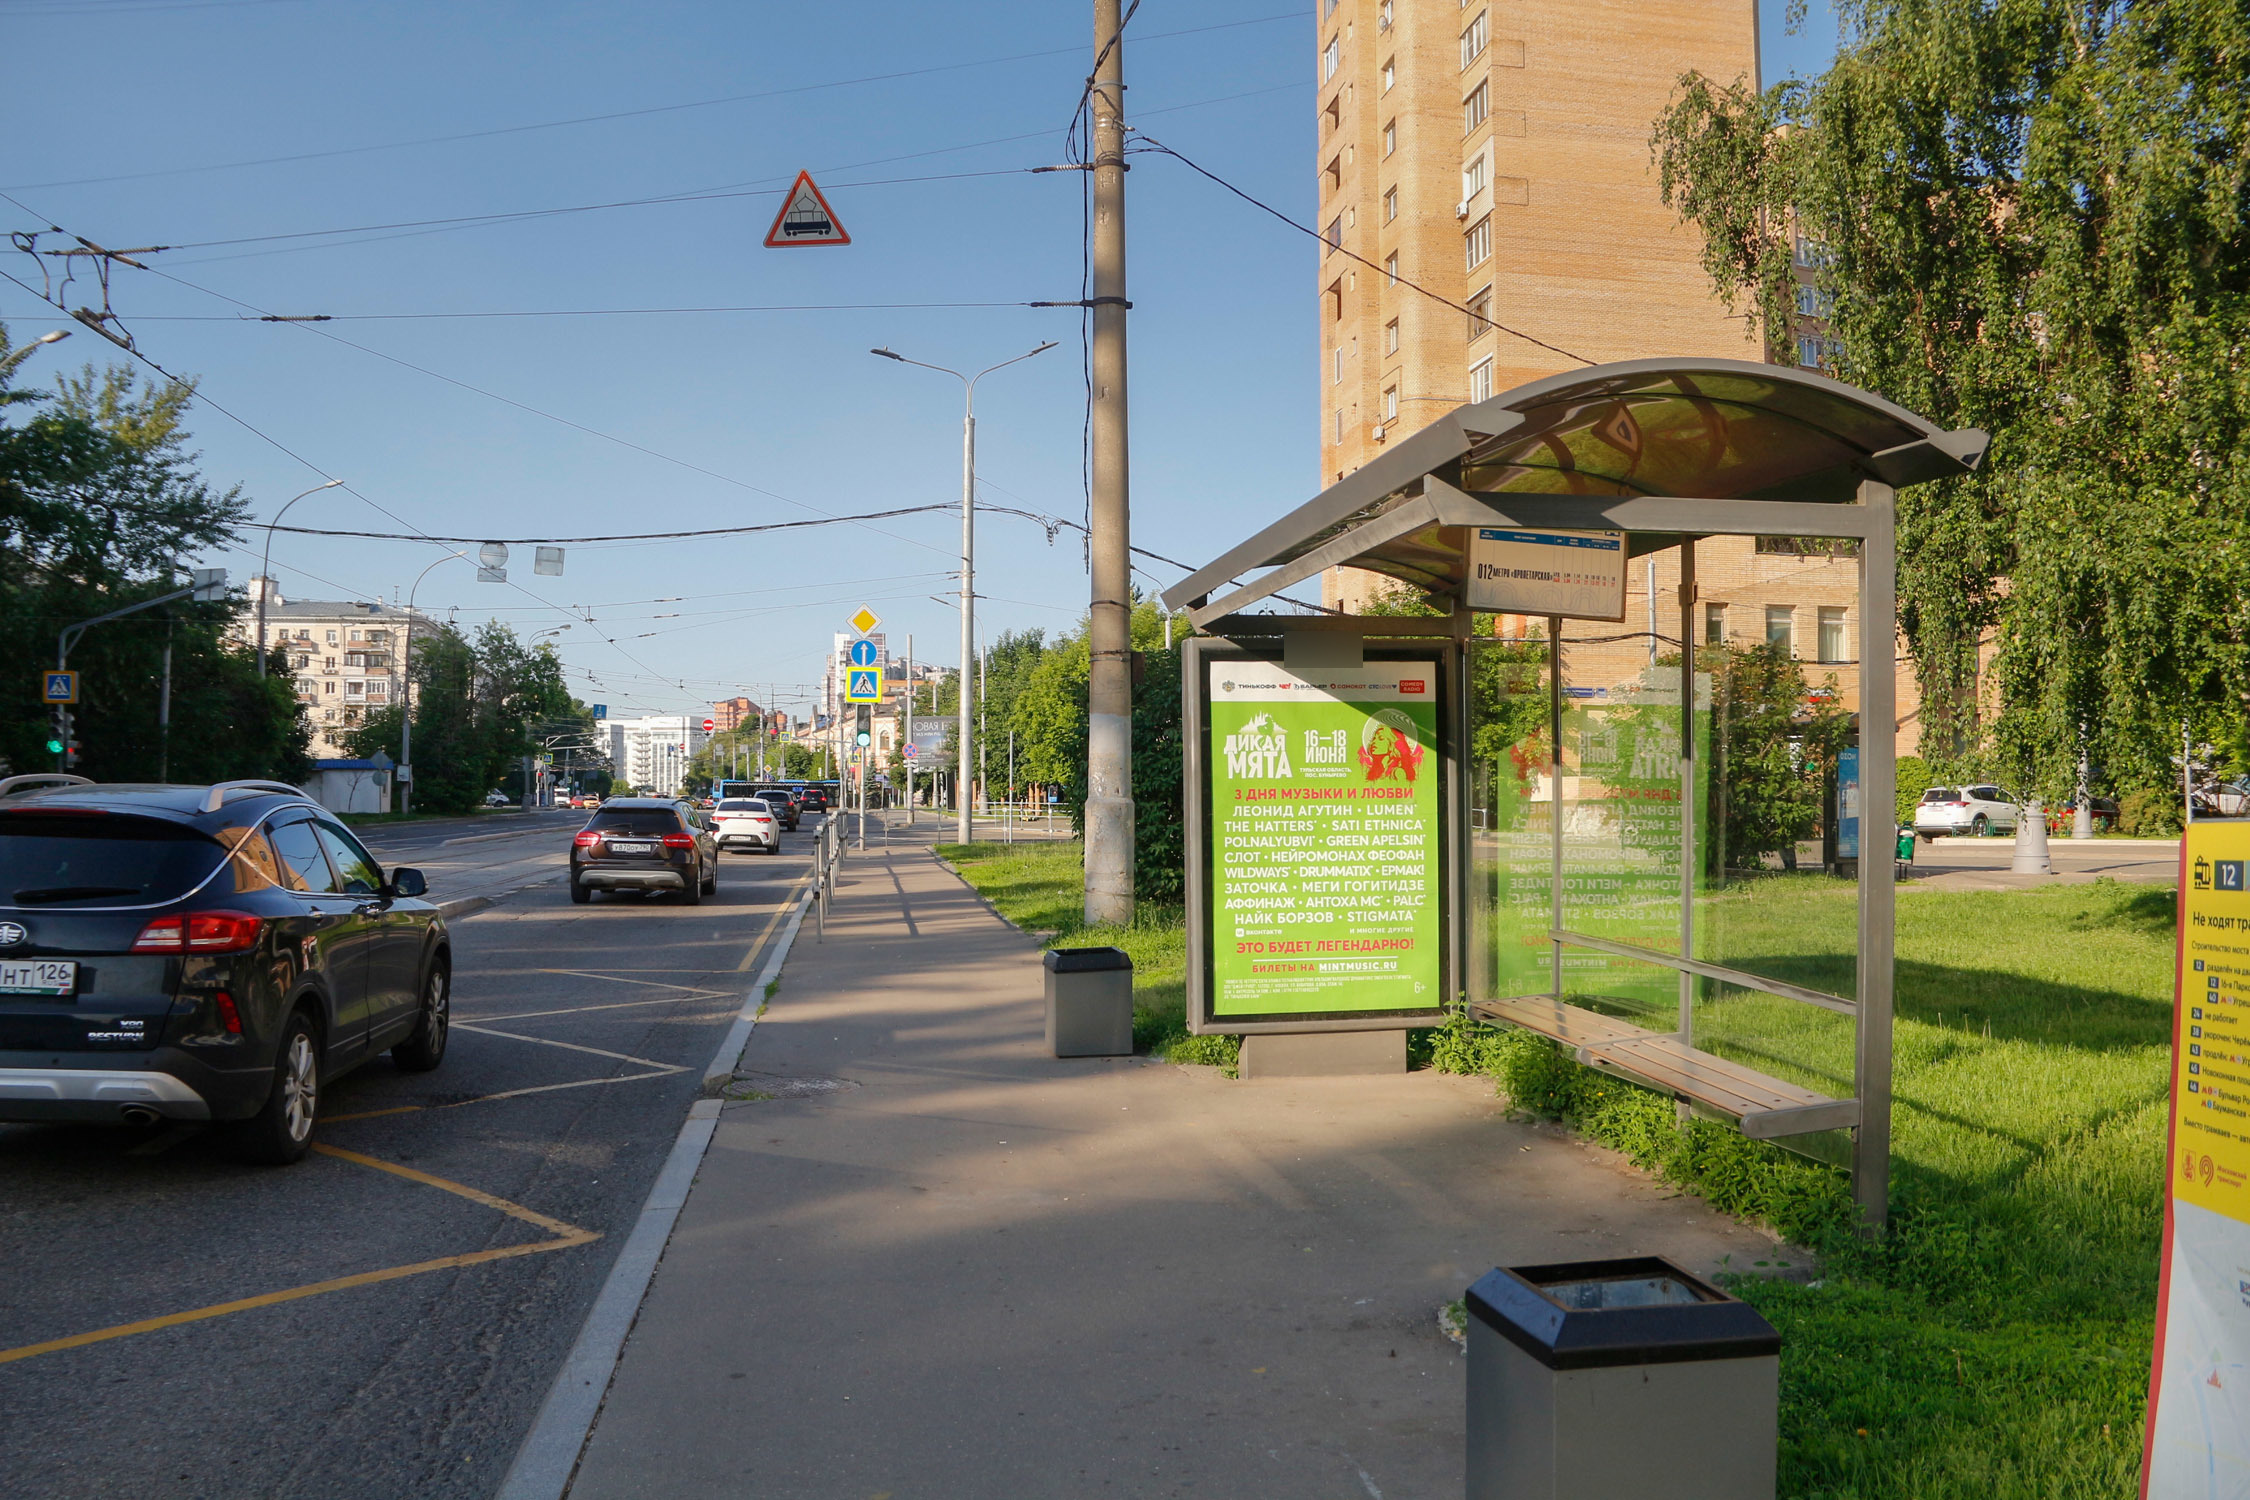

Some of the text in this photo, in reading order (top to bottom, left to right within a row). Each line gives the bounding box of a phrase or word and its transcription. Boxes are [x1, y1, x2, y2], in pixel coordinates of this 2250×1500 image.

[1477, 562, 1493, 580] 012
[1493, 567, 1510, 578] МЕТРО
[912, 721, 938, 732] ОВАЯ
[1224, 734, 1286, 756] ДИКАЯ
[1305, 747, 1347, 764] ИЮНЯ
[1228, 750, 1293, 779] МЯТА
[1234, 787, 1414, 801] 3 ДНЯ МУЗЫКИ И ЛЮБВИ
[1233, 805, 1294, 818] ЛЕОНИД
[1298, 804, 1352, 816] АГУТИН
[1224, 821, 1250, 832] THE
[1332, 820, 1360, 831] SATI
[1326, 835, 1369, 847] GREEN
[1224, 849, 1424, 864] СЛОТ НЕЙРОМОНАХ ФЕОФАН
[1382, 864, 1425, 876] ЕРМАК!
[2222, 864, 2236, 887] 12
[1225, 880, 1425, 895] ЗАТОЧКА МЕГИ ГОГИТИДЗЕ
[1225, 897, 1295, 910] АФФИНАЖ
[1305, 896, 1358, 909] АНТОХА
[1235, 910, 1273, 925] НАЙК
[1277, 911, 1334, 924] БОРЗОВ
[2193, 911, 2205, 926] Не
[2208, 915, 2235, 931] ходят
[1387, 926, 1414, 935] ДРУГИЕ
[1236, 938, 1414, 955] ЭТО БУДЕТ ЛЕГЕНДАРНО!
[2191, 940, 2249, 955] Строительство моста
[36, 963, 68, 980] 126
[1252, 961, 1398, 973] БИЛЕТЫ НА MINTMUSIC.RU
[2195, 960, 2202, 970] 12
[2233, 967, 2241, 975] на
[1414, 981, 1427, 994] 6+
[2209, 978, 2217, 988] 12
[2208, 992, 2217, 1003] 40
[2193, 1009, 2238, 1025] 24 не работает
[88, 1032, 145, 1041] BESTURN
[2192, 1026, 2199, 1036] 38
[2191, 1044, 2199, 1054] 43
[2202, 1066, 2236, 1082] Новоконная
[2218, 1089, 2241, 1104] Бульвар
[2212, 1101, 2246, 1118] Бауманская
[2184, 1117, 2203, 1130] Вместо
[2204, 1124, 2231, 1138] трамваев
